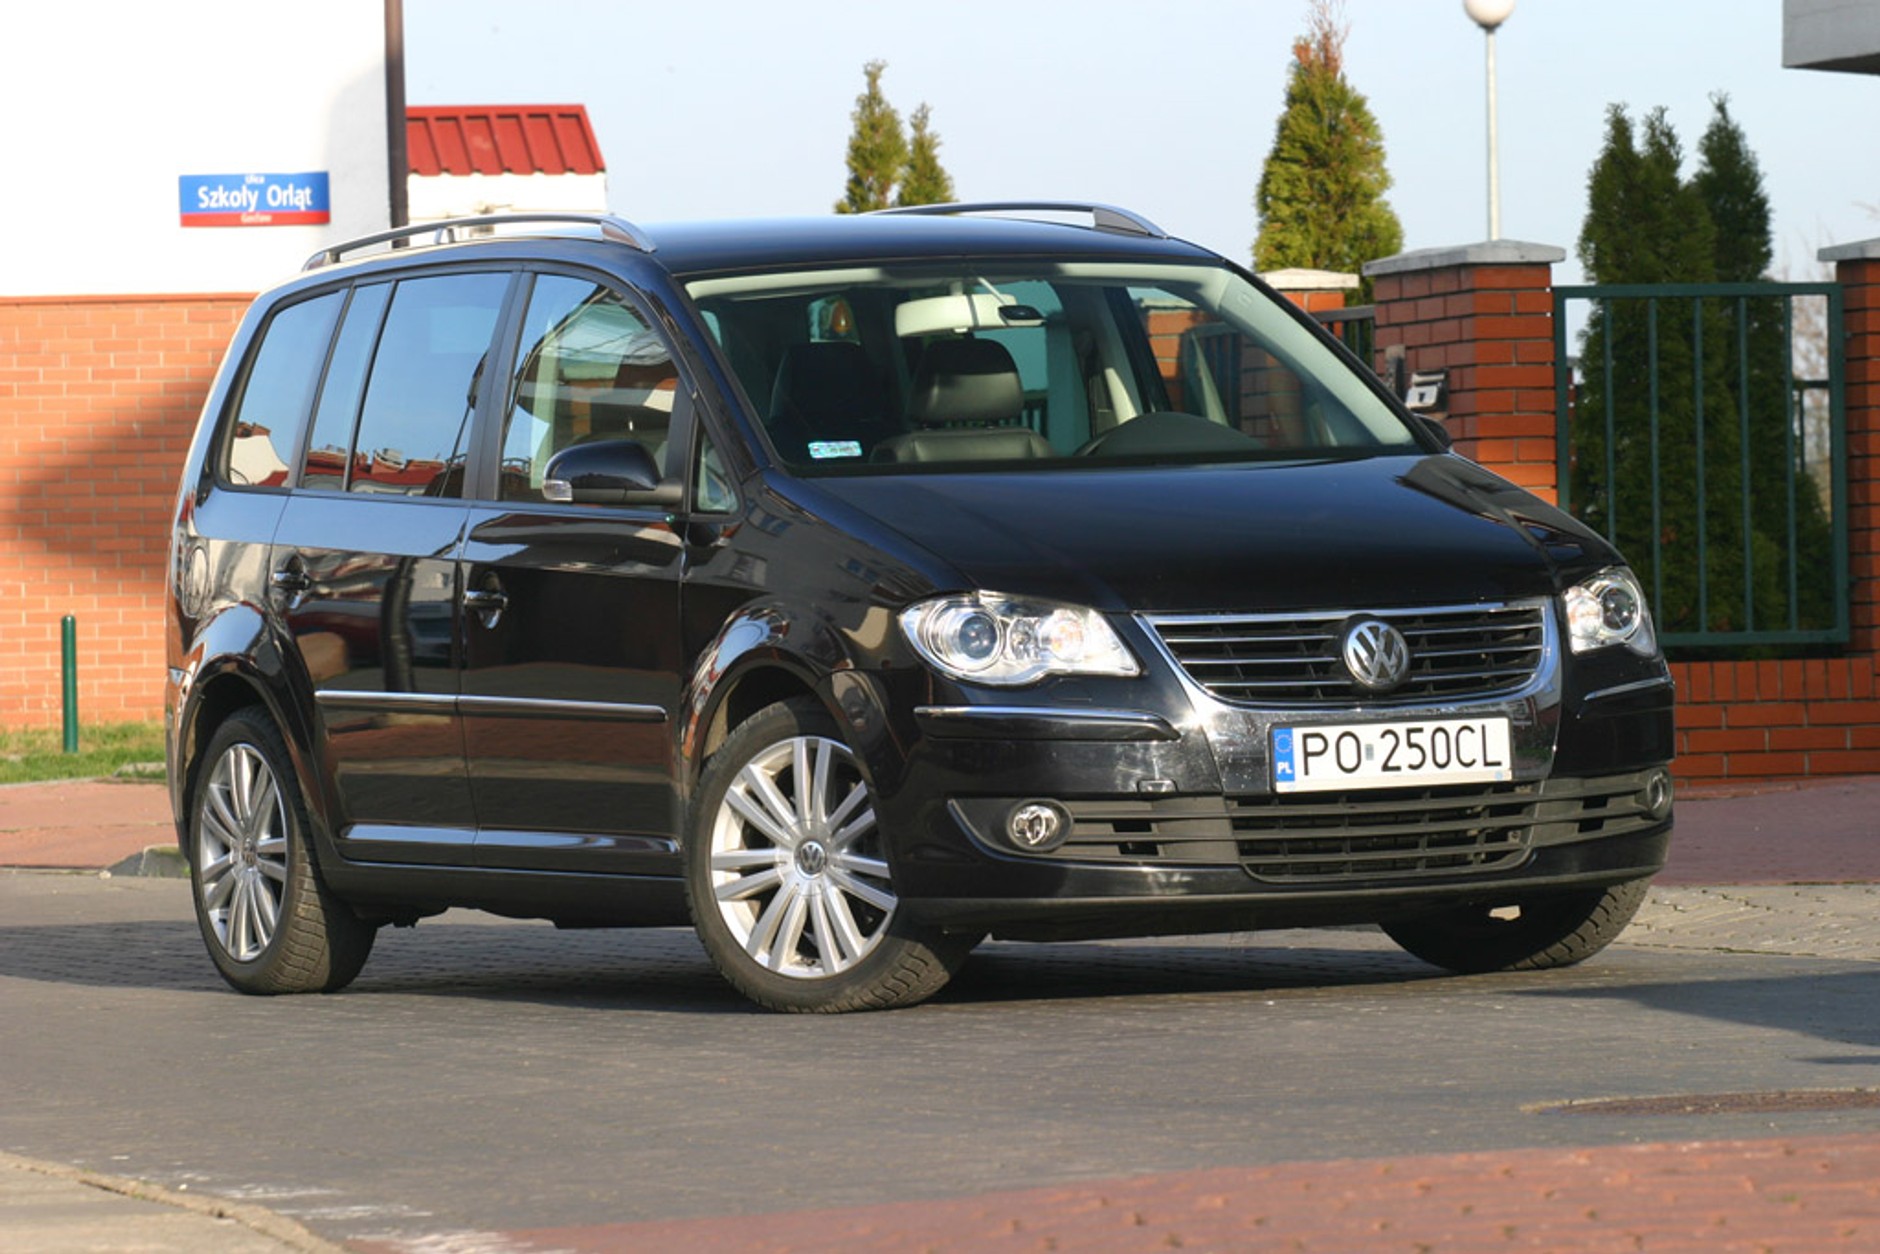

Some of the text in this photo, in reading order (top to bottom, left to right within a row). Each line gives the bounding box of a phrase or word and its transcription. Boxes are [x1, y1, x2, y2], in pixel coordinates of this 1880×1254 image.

[266, 183, 312, 211] Orląt
[1302, 724, 1502, 776] PO 250CL
[1277, 761, 1293, 775] PL
